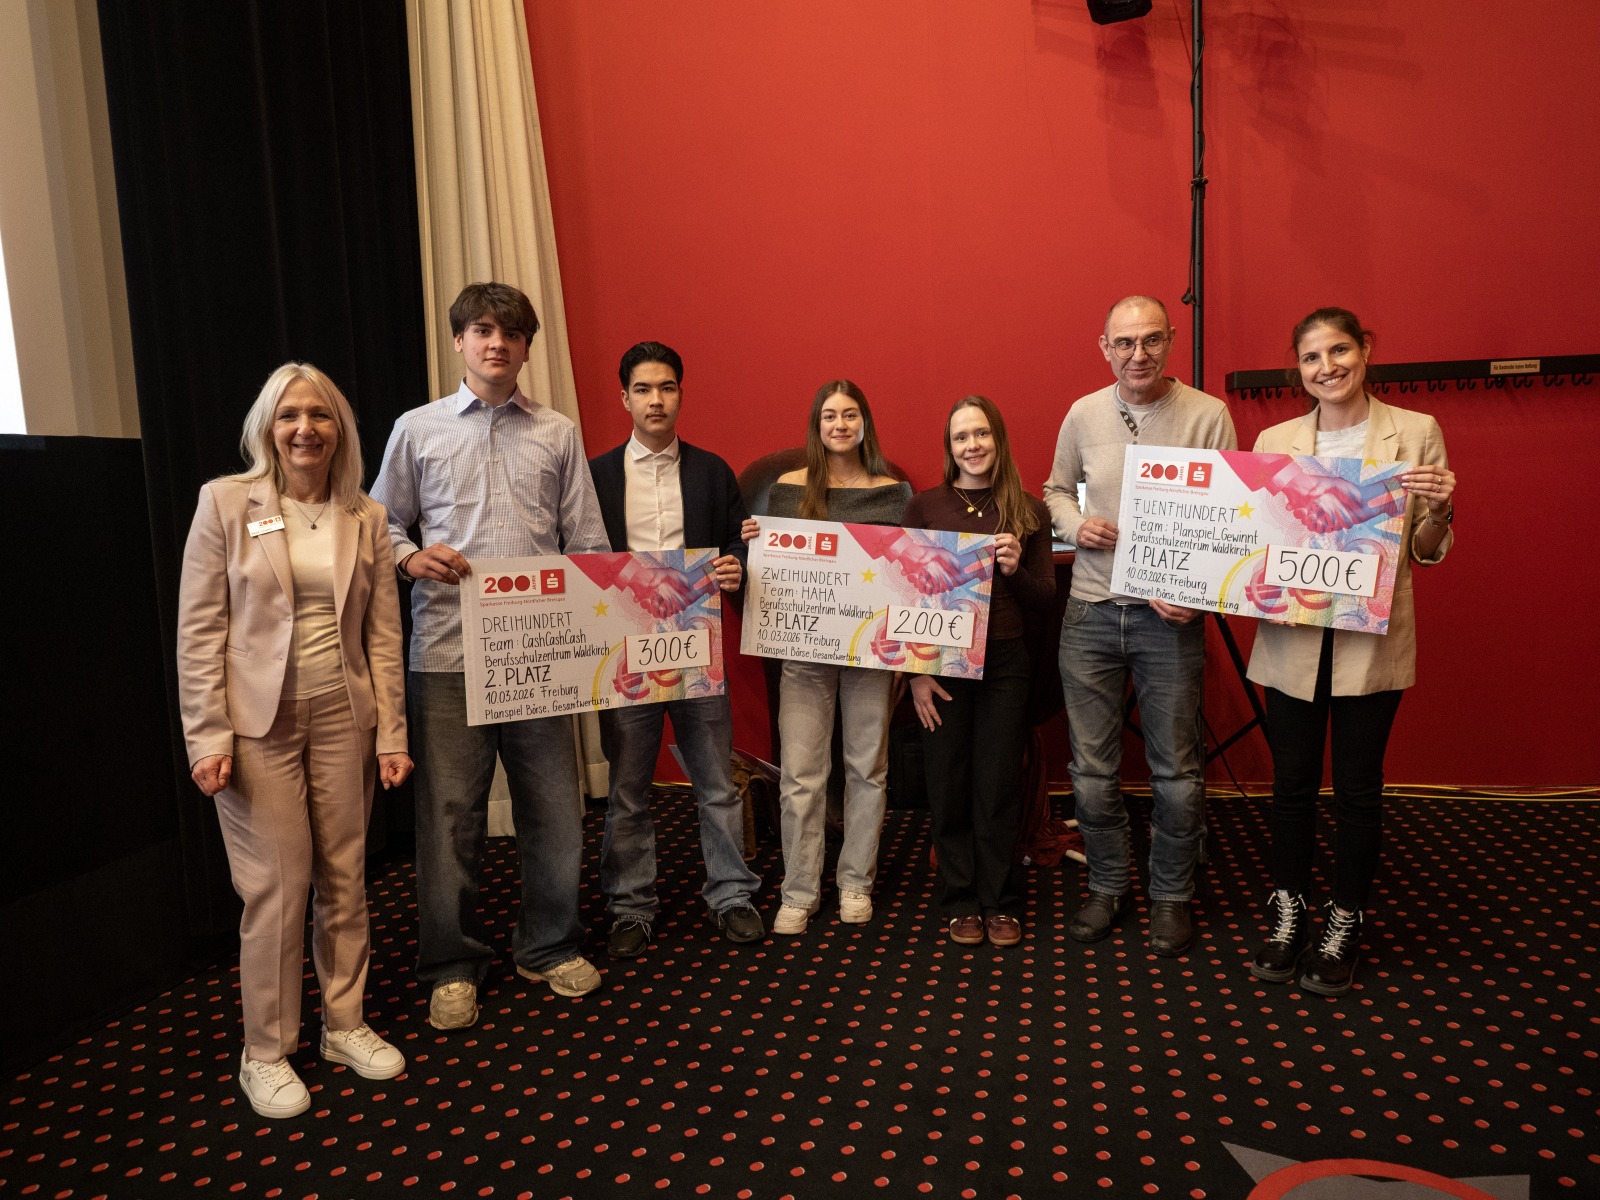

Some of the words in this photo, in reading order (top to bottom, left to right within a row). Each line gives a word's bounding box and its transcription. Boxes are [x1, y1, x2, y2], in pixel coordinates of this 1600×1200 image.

[1141, 463, 1178, 480] 200
[768, 533, 807, 549] 200
[1132, 531, 1209, 551] Berufsschulzentrum
[1212, 542, 1251, 557] Waldkirch
[1173, 522, 1258, 545] Planspiel_Gewinnt
[1129, 544, 1137, 564] 1.
[1142, 546, 1191, 571] PLATZ
[484, 575, 530, 593] 200
[761, 567, 851, 586] ZWEIHUNDERT
[1126, 567, 1167, 583] 10.03.2026
[1169, 573, 1208, 594] Freiburg
[801, 587, 836, 602] HAHA
[1124, 582, 1154, 598] Planspiel
[1156, 590, 1176, 601] Börse,
[1178, 593, 1239, 613] Gesamtwertung
[760, 597, 836, 615] Berufsschulzentrum
[838, 603, 874, 620] Waldkirch
[483, 612, 573, 633] DREIHUNDERT
[760, 610, 772, 627] 3.
[776, 612, 820, 632] PLATZ
[522, 629, 586, 649] CashCashCash
[638, 634, 698, 666] 300€
[758, 629, 801, 642] 10.03.2026
[803, 633, 841, 651] Freiburg
[485, 649, 571, 668] Berufsschulzentrum
[573, 641, 610, 658] Waldkirch
[756, 643, 788, 657] Planspiel
[812, 649, 861, 665] Gesamtwertung
[484, 669, 501, 688] 2.
[506, 665, 552, 685] PLATZ
[485, 688, 534, 704] 10.03.2026
[540, 685, 579, 699] Freiburg
[485, 705, 522, 720] Planspiel
[526, 703, 550, 715] Börse,
[552, 697, 610, 712] Gesamtwertung
